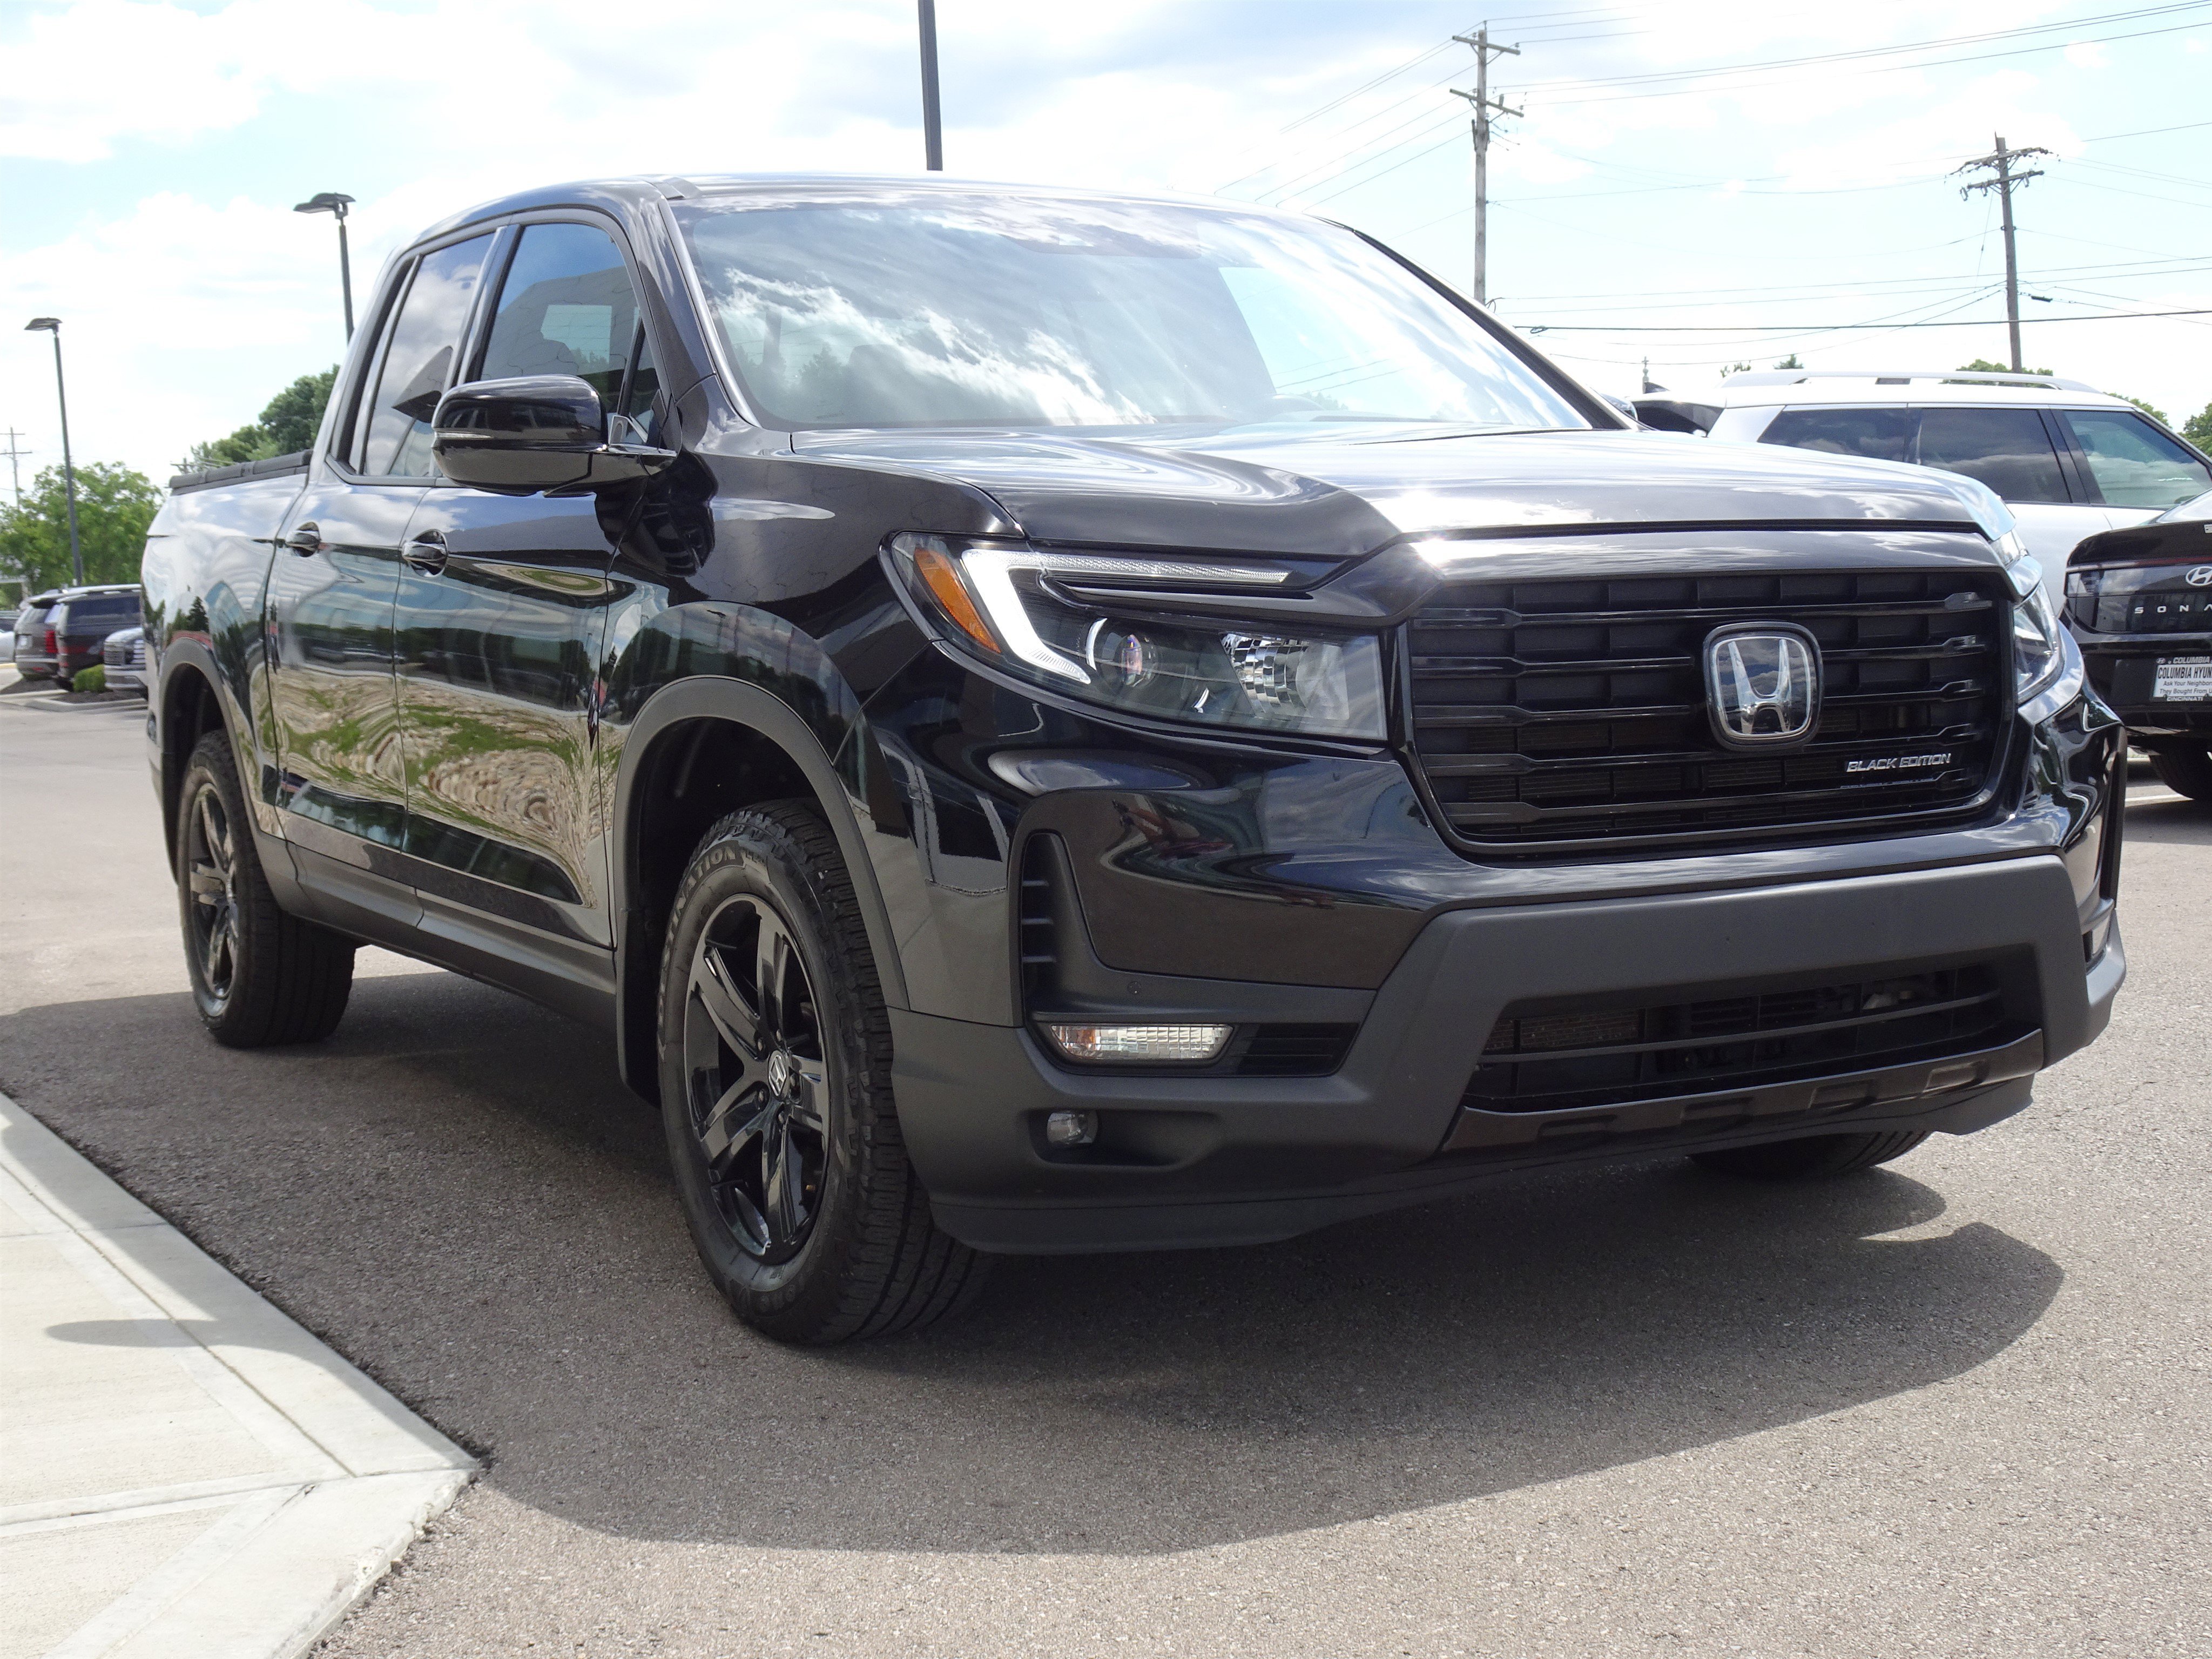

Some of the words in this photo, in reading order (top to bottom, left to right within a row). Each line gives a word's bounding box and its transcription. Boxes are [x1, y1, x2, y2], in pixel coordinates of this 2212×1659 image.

[2158, 667, 2191, 679] COLUMBIA
[1846, 758, 1898, 772] BLACK
[1899, 753, 1952, 768] EDITION
